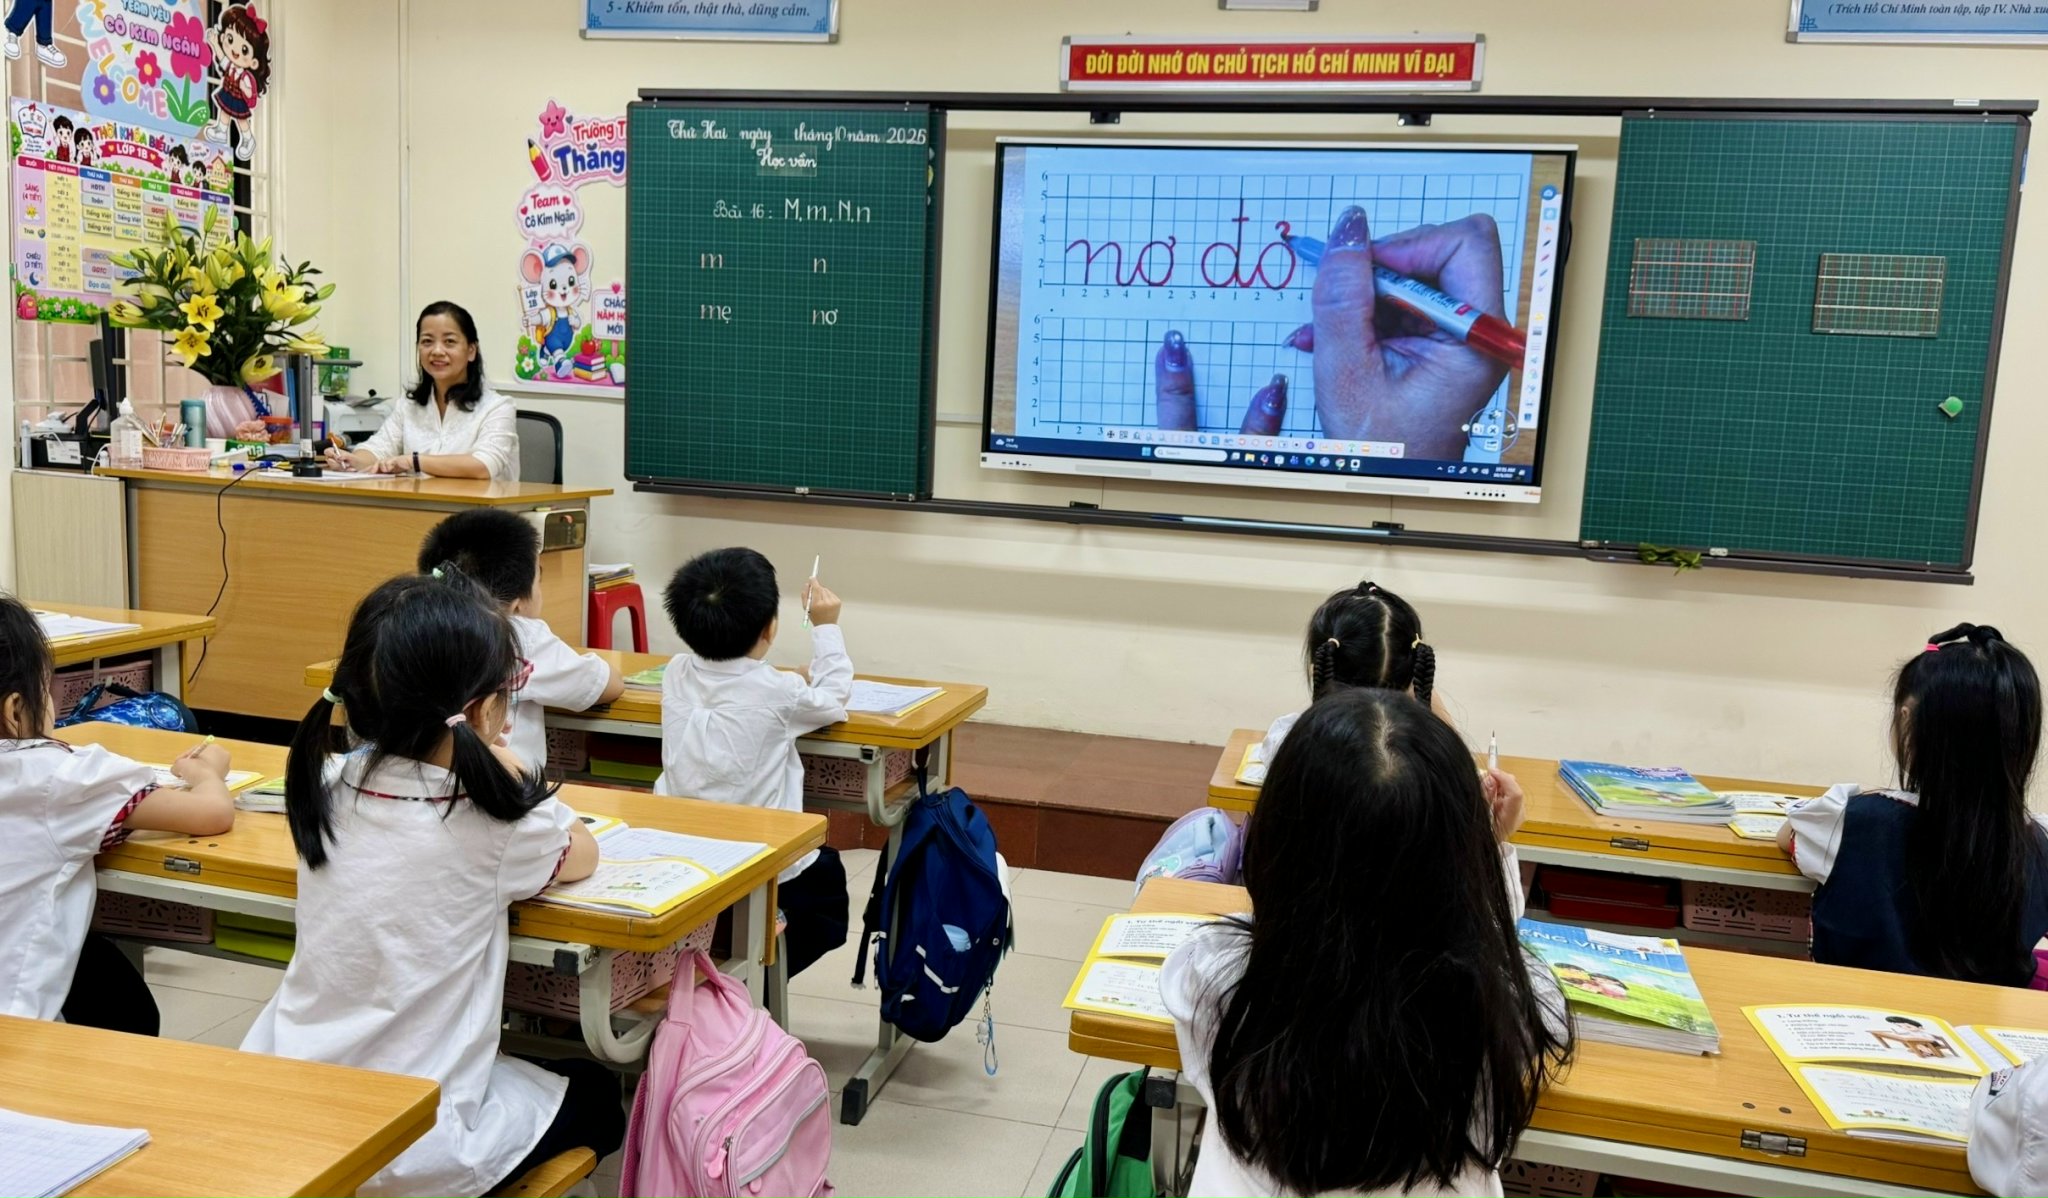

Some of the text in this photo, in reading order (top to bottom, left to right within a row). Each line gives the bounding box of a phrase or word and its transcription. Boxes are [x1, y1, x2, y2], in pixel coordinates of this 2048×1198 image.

[606, 1, 614, 13] 5
[693, 1, 718, 17] thật
[748, 2, 778, 18] dũng
[781, 3, 811, 18] cảm.
[1835, 3, 1859, 14] Trích
[1863, 2, 1878, 14] Hồ
[1881, 3, 1899, 14] Chí
[1900, 4, 1926, 14] Minh
[1929, 4, 1951, 14] toàn
[1974, 4, 1991, 17] tập
[2010, 4, 2031, 14] Nhà
[104, 14, 200, 59] CÔ KIM NGÂN
[1086, 47, 1455, 78] ĐỜI ĐỜI NHỚ ƠN CHỦ TỊCH HỒ CHÍ MINH VĨ ĐẠI
[667, 119, 697, 140] Thứ
[700, 119, 728, 140] Hai
[740, 127, 772, 150] ngày
[794, 121, 834, 151] tháng
[116, 143, 148, 159] LỚP 1B
[756, 148, 817, 170] Học vần
[553, 142, 625, 177] Thăng
[531, 193, 560, 209] Team
[713, 200, 742, 219] Bài
[525, 209, 575, 228] Cô Kim Ngân
[1065, 198, 1296, 290] nơ đỏ
[700, 253, 827, 274] m n
[525, 289, 538, 299] Lớp
[528, 299, 538, 308] 1B
[597, 309, 615, 320] NĂM
[700, 303, 839, 325] mẹ nơ
[1034, 314, 1040, 324] 6
[1033, 333, 1040, 343] 5
[1032, 356, 1039, 366] 4
[1032, 375, 1038, 385] 3
[1031, 398, 1038, 408] 2
[1032, 418, 1036, 428] 1
[1076, 426, 1082, 435] 2
